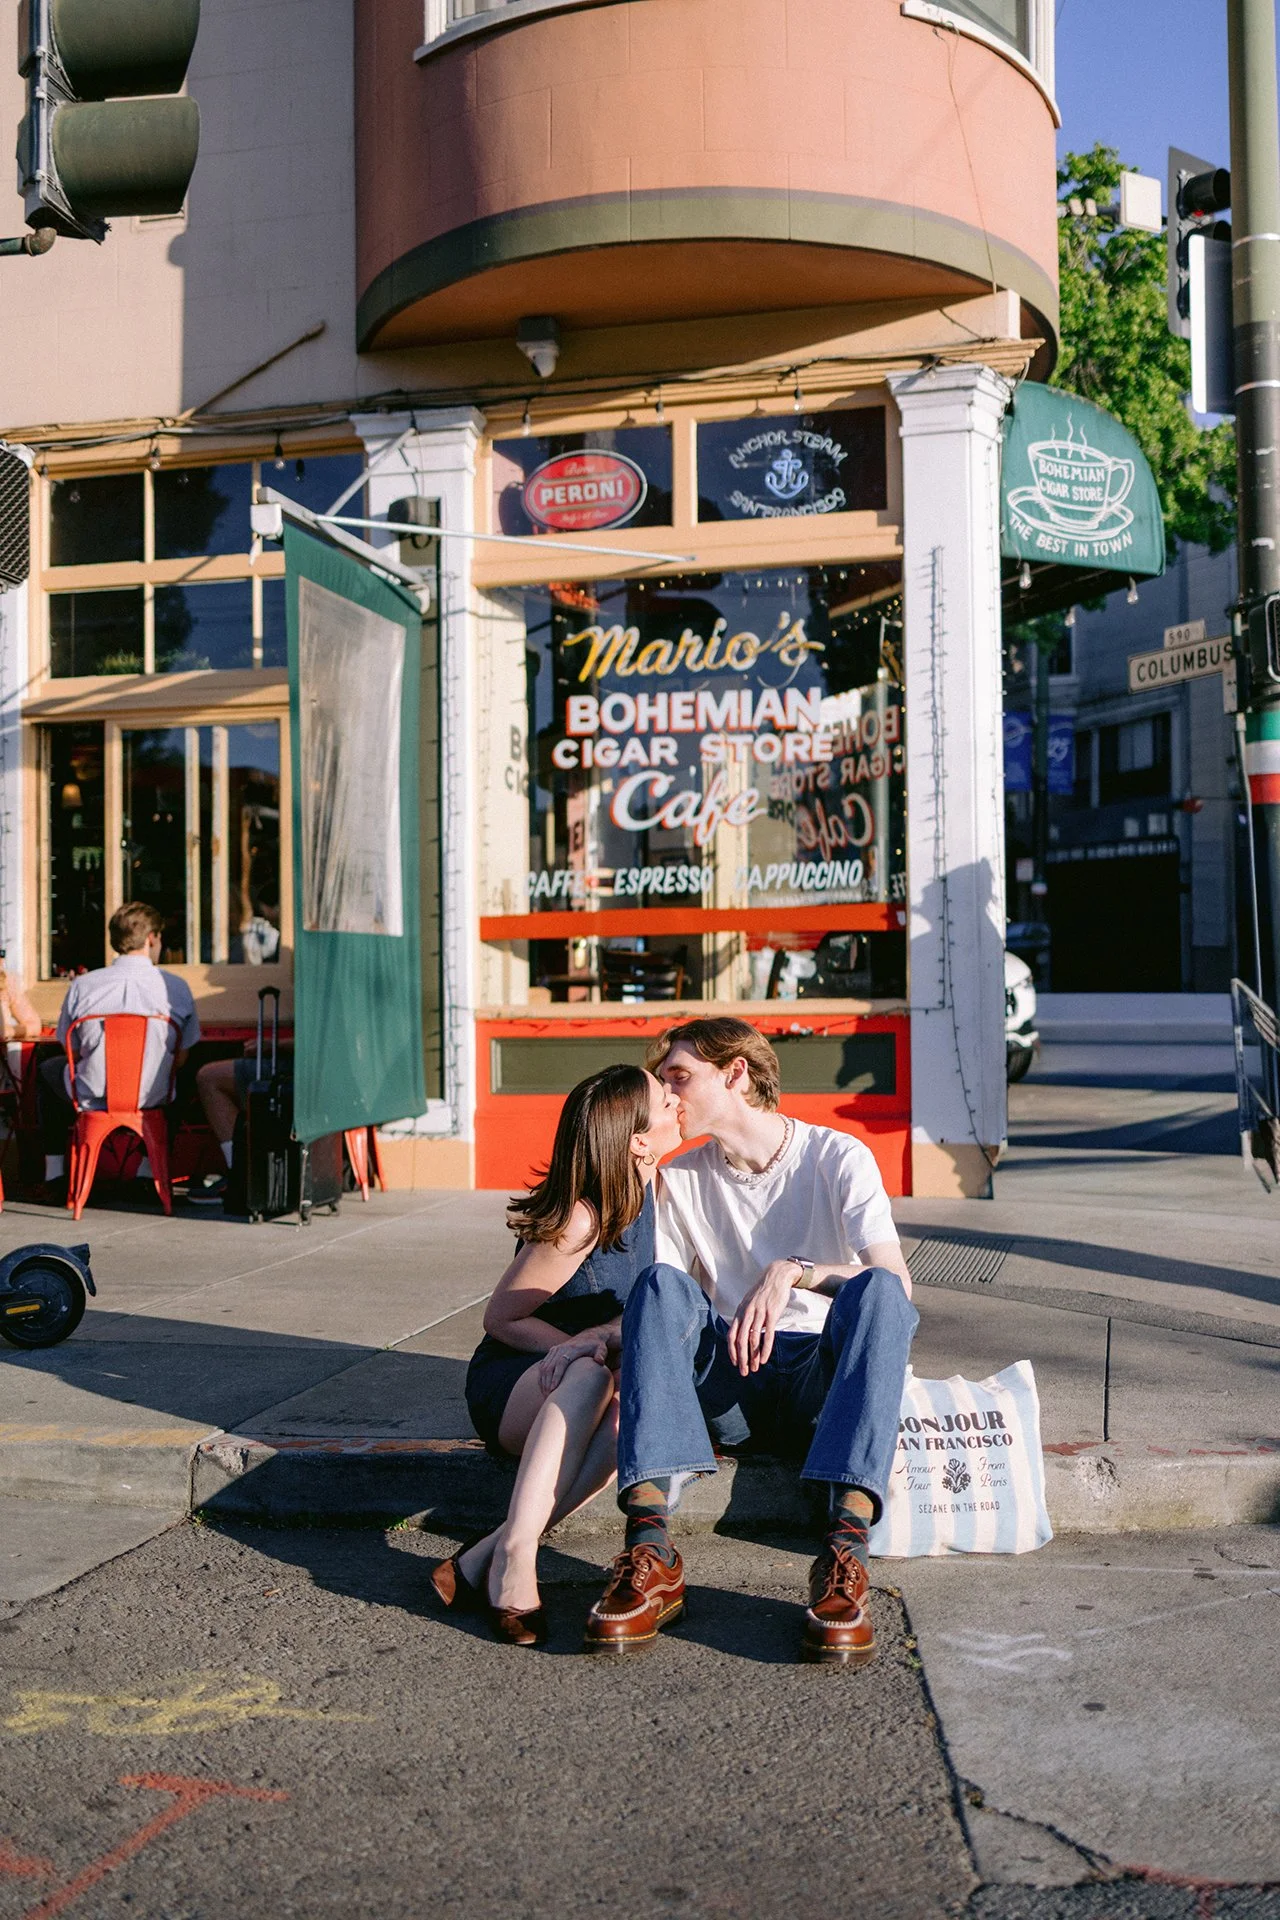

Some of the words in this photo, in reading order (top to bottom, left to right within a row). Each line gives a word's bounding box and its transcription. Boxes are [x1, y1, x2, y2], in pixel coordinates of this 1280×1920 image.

[729, 430, 791, 469] ANCHOR
[792, 430, 848, 467] STEAM
[1039, 459, 1105, 482] BOHEMIAN
[540, 479, 624, 506] PERONI
[730, 490, 762, 516] SAN
[760, 487, 847, 518] FRANCISCO
[1040, 477, 1070, 499] CIGAR
[1072, 486, 1104, 502] STORE
[1009, 512, 1034, 541] THE
[1036, 533, 1069, 554] BEST
[1074, 543, 1089, 557] IN
[1093, 531, 1133, 556] TOWN
[563, 611, 826, 684] Mario's
[1168, 629, 1191, 646] 590
[1137, 642, 1233, 682] COLUMBUS
[566, 688, 822, 736] BOHEMIAN
[552, 738, 679, 770] CIGAR
[700, 731, 834, 765] STORE
[610, 769, 768, 847] Cafe
[613, 864, 714, 895] ESPRESSO
[896, 1437, 920, 1450] AN
[925, 1433, 1013, 1450] FRANCISCO
[895, 1459, 936, 1474] Amour
[977, 1456, 1005, 1471] From
[980, 1473, 1007, 1488] Paris
[951, 1504, 961, 1513] ON
[964, 1502, 977, 1512] THE
[981, 1500, 1000, 1511] ROAD
